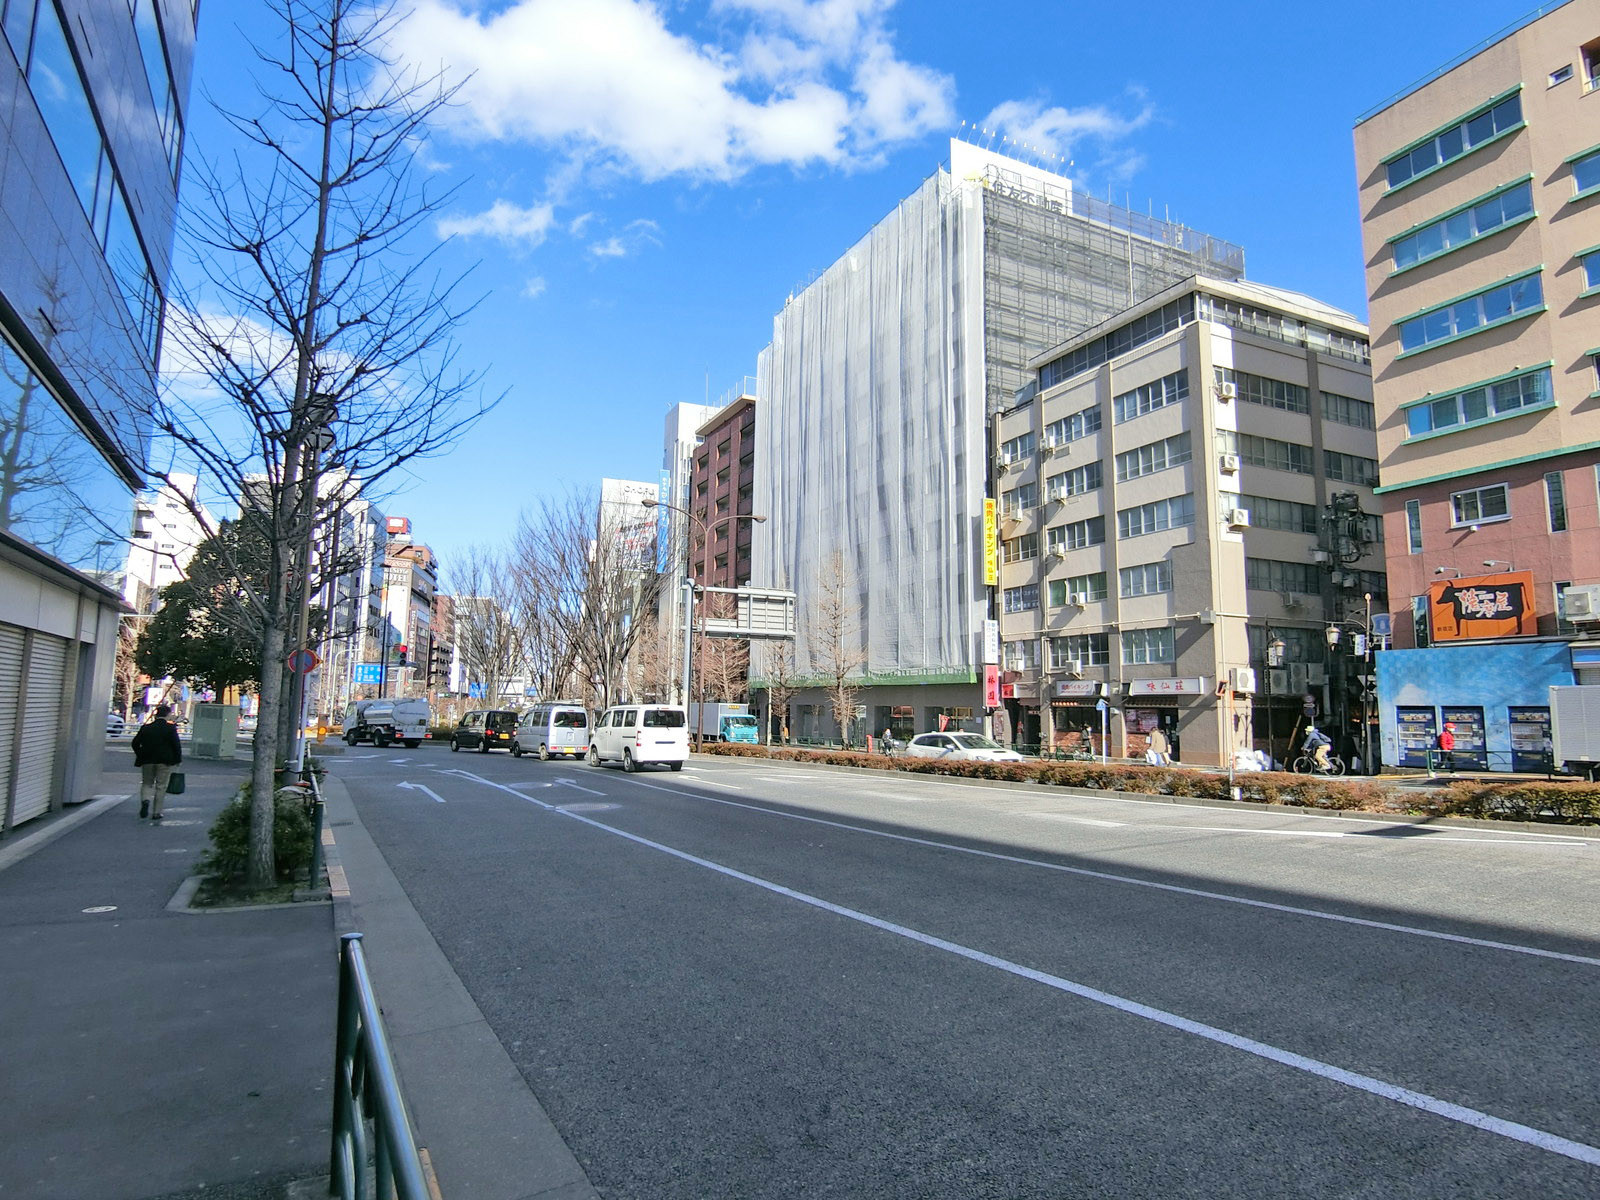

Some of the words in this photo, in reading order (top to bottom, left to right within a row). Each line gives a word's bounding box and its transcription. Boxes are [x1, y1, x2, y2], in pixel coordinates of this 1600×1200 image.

[992, 180, 1063, 214] 住友不動産
[986, 502, 994, 556] 焼肉バイキング
